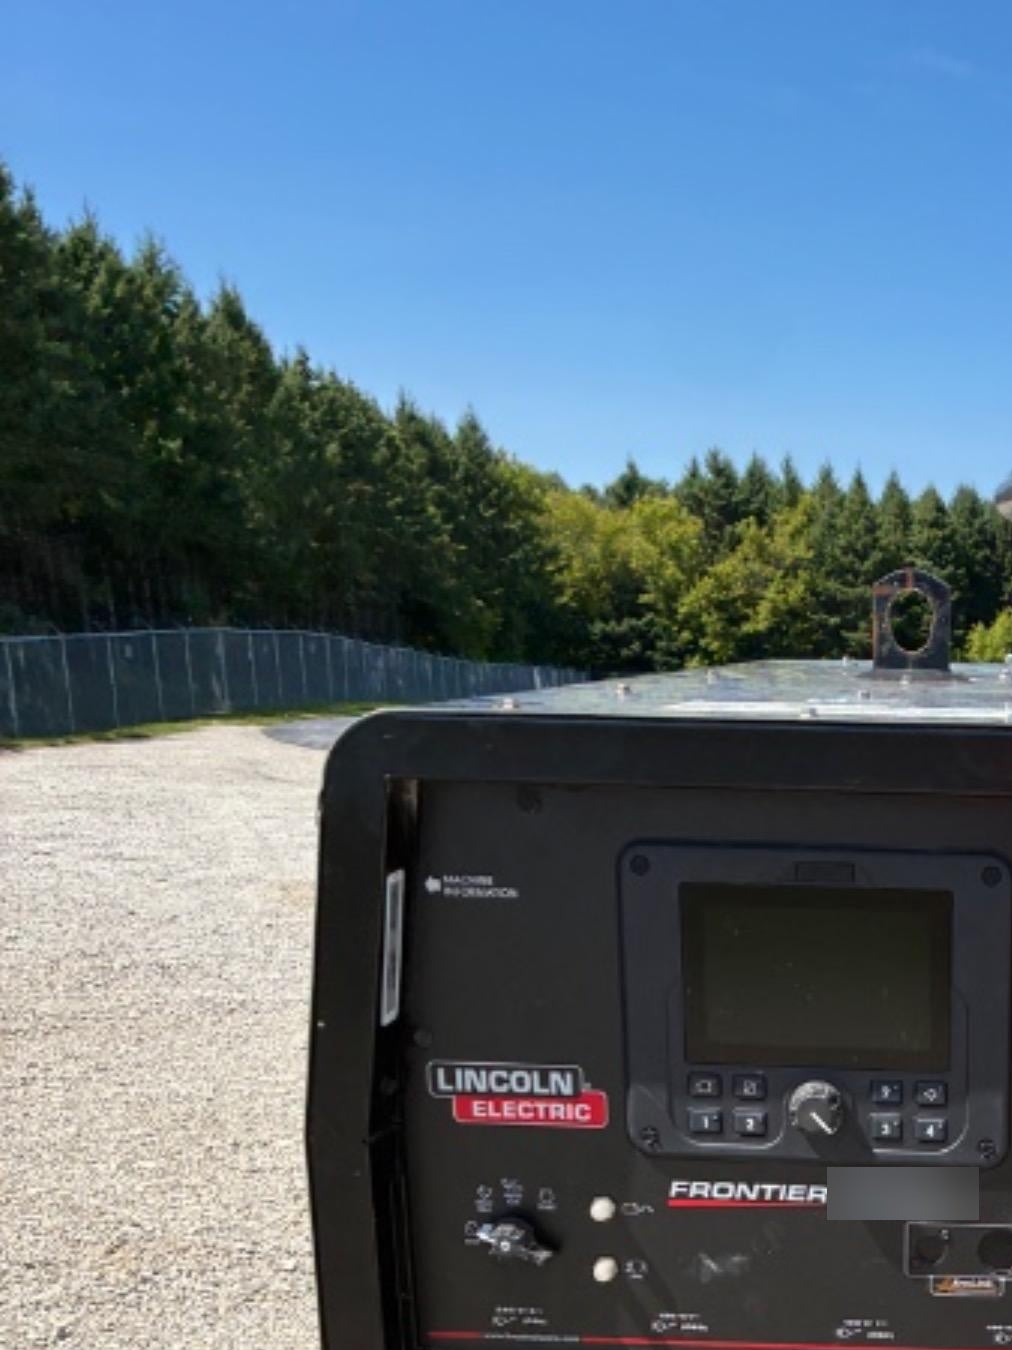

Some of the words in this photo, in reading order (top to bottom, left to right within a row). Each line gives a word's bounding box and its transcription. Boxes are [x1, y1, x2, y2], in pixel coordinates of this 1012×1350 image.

[436, 1067, 574, 1096] LINCOLN
[472, 1100, 592, 1121] ELECTRIC
[669, 1180, 827, 1204] FRONTIER
